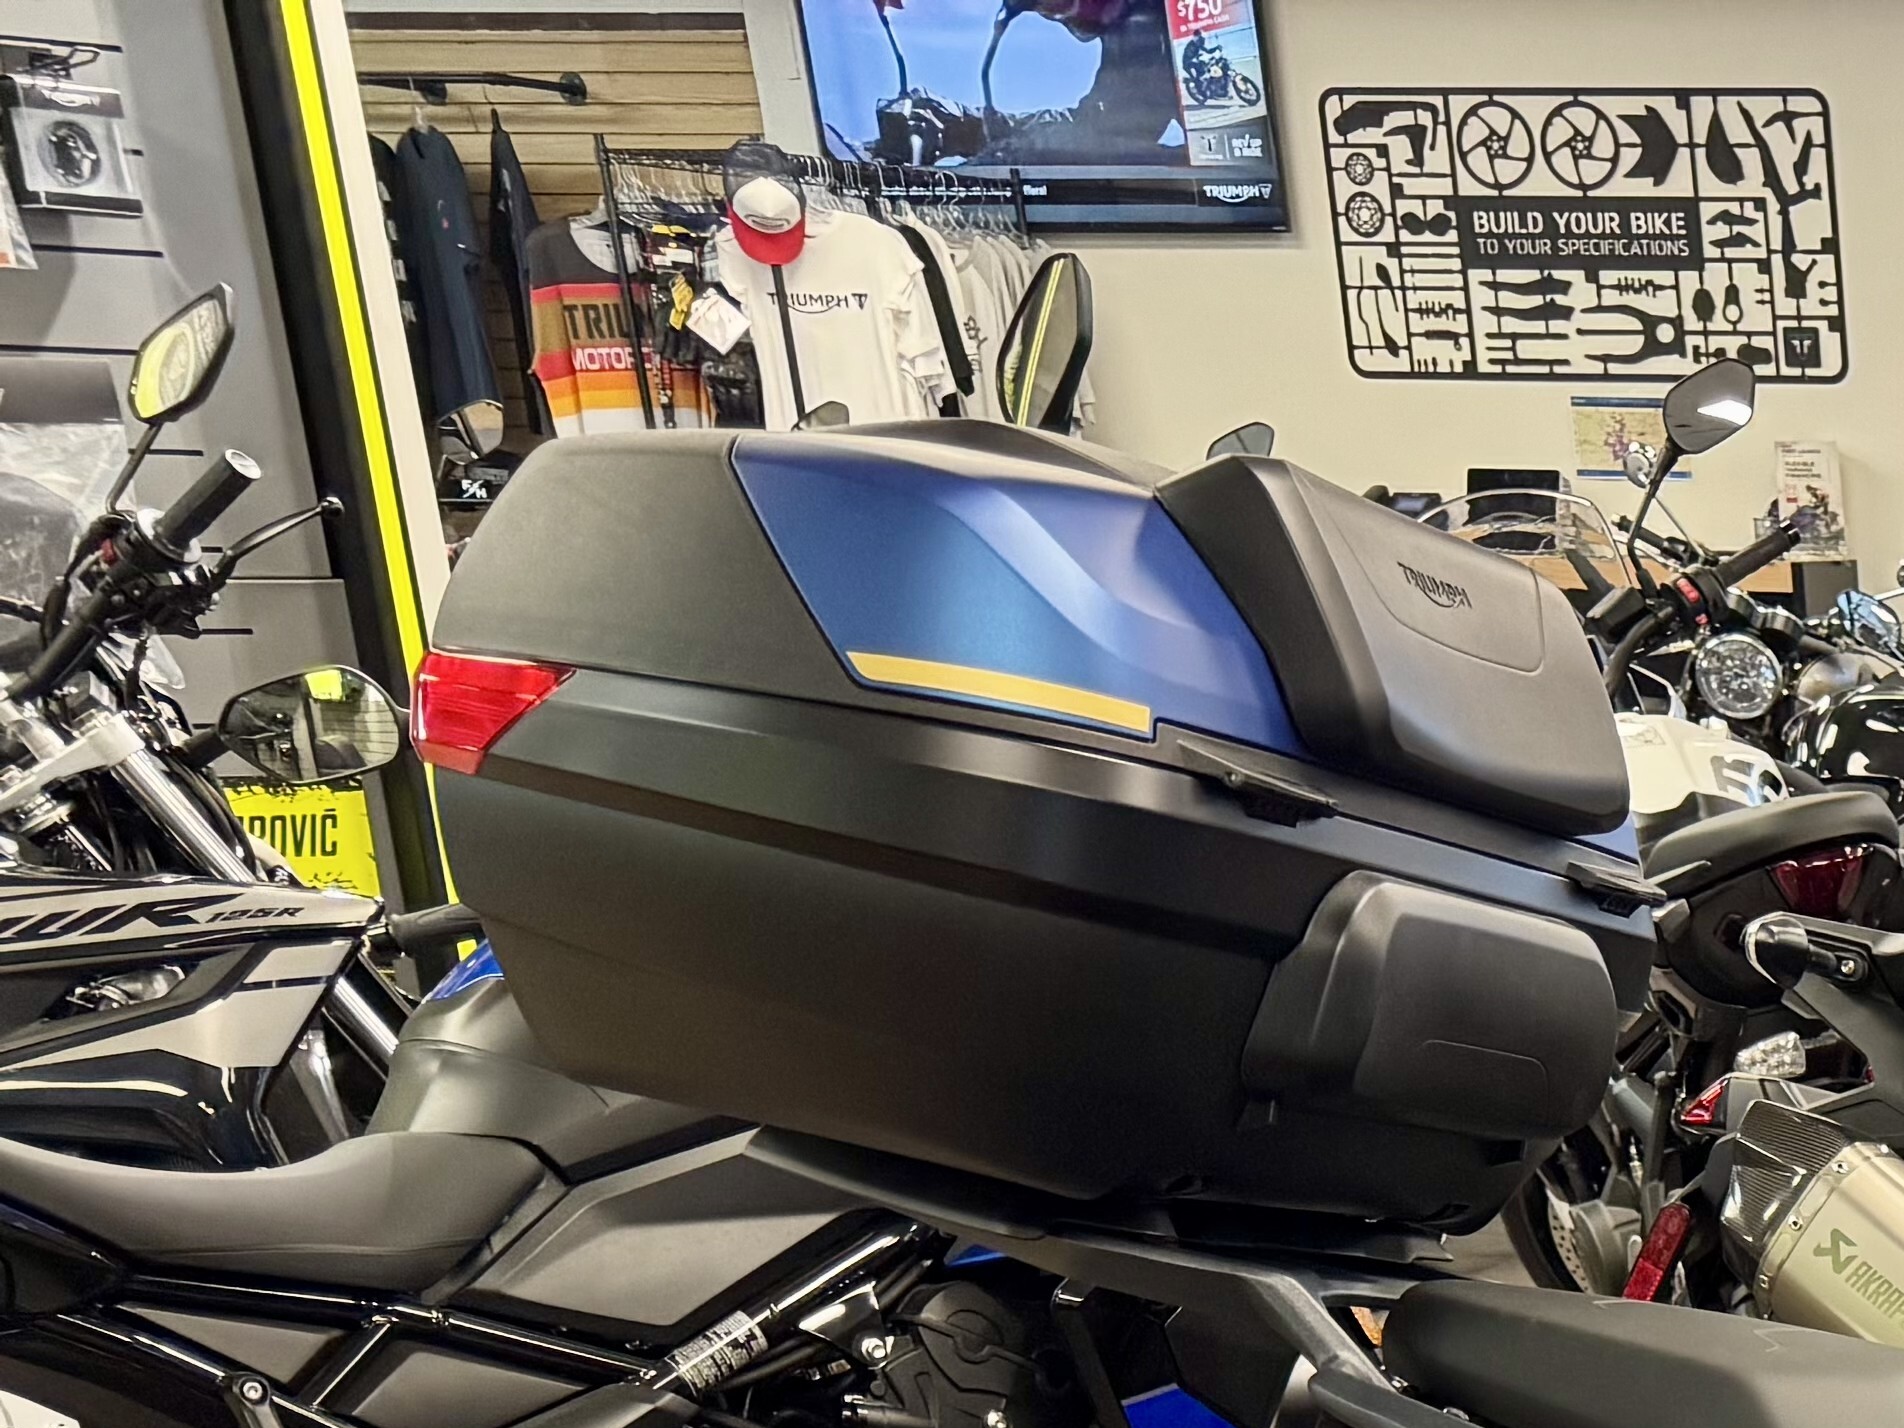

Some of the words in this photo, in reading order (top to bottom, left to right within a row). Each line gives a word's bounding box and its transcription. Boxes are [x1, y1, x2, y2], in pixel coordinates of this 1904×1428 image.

[1203, 184, 1260, 203] TRIUMPH
[1473, 211, 1544, 234] BUILD
[1552, 212, 1621, 235] YOUR
[1630, 212, 1688, 235] BIKE
[1476, 238, 1499, 255] TO
[1504, 238, 1552, 256] YOUR
[1557, 239, 1690, 256] SPECIFICATIONS
[236, 808, 338, 857] POVIČ
